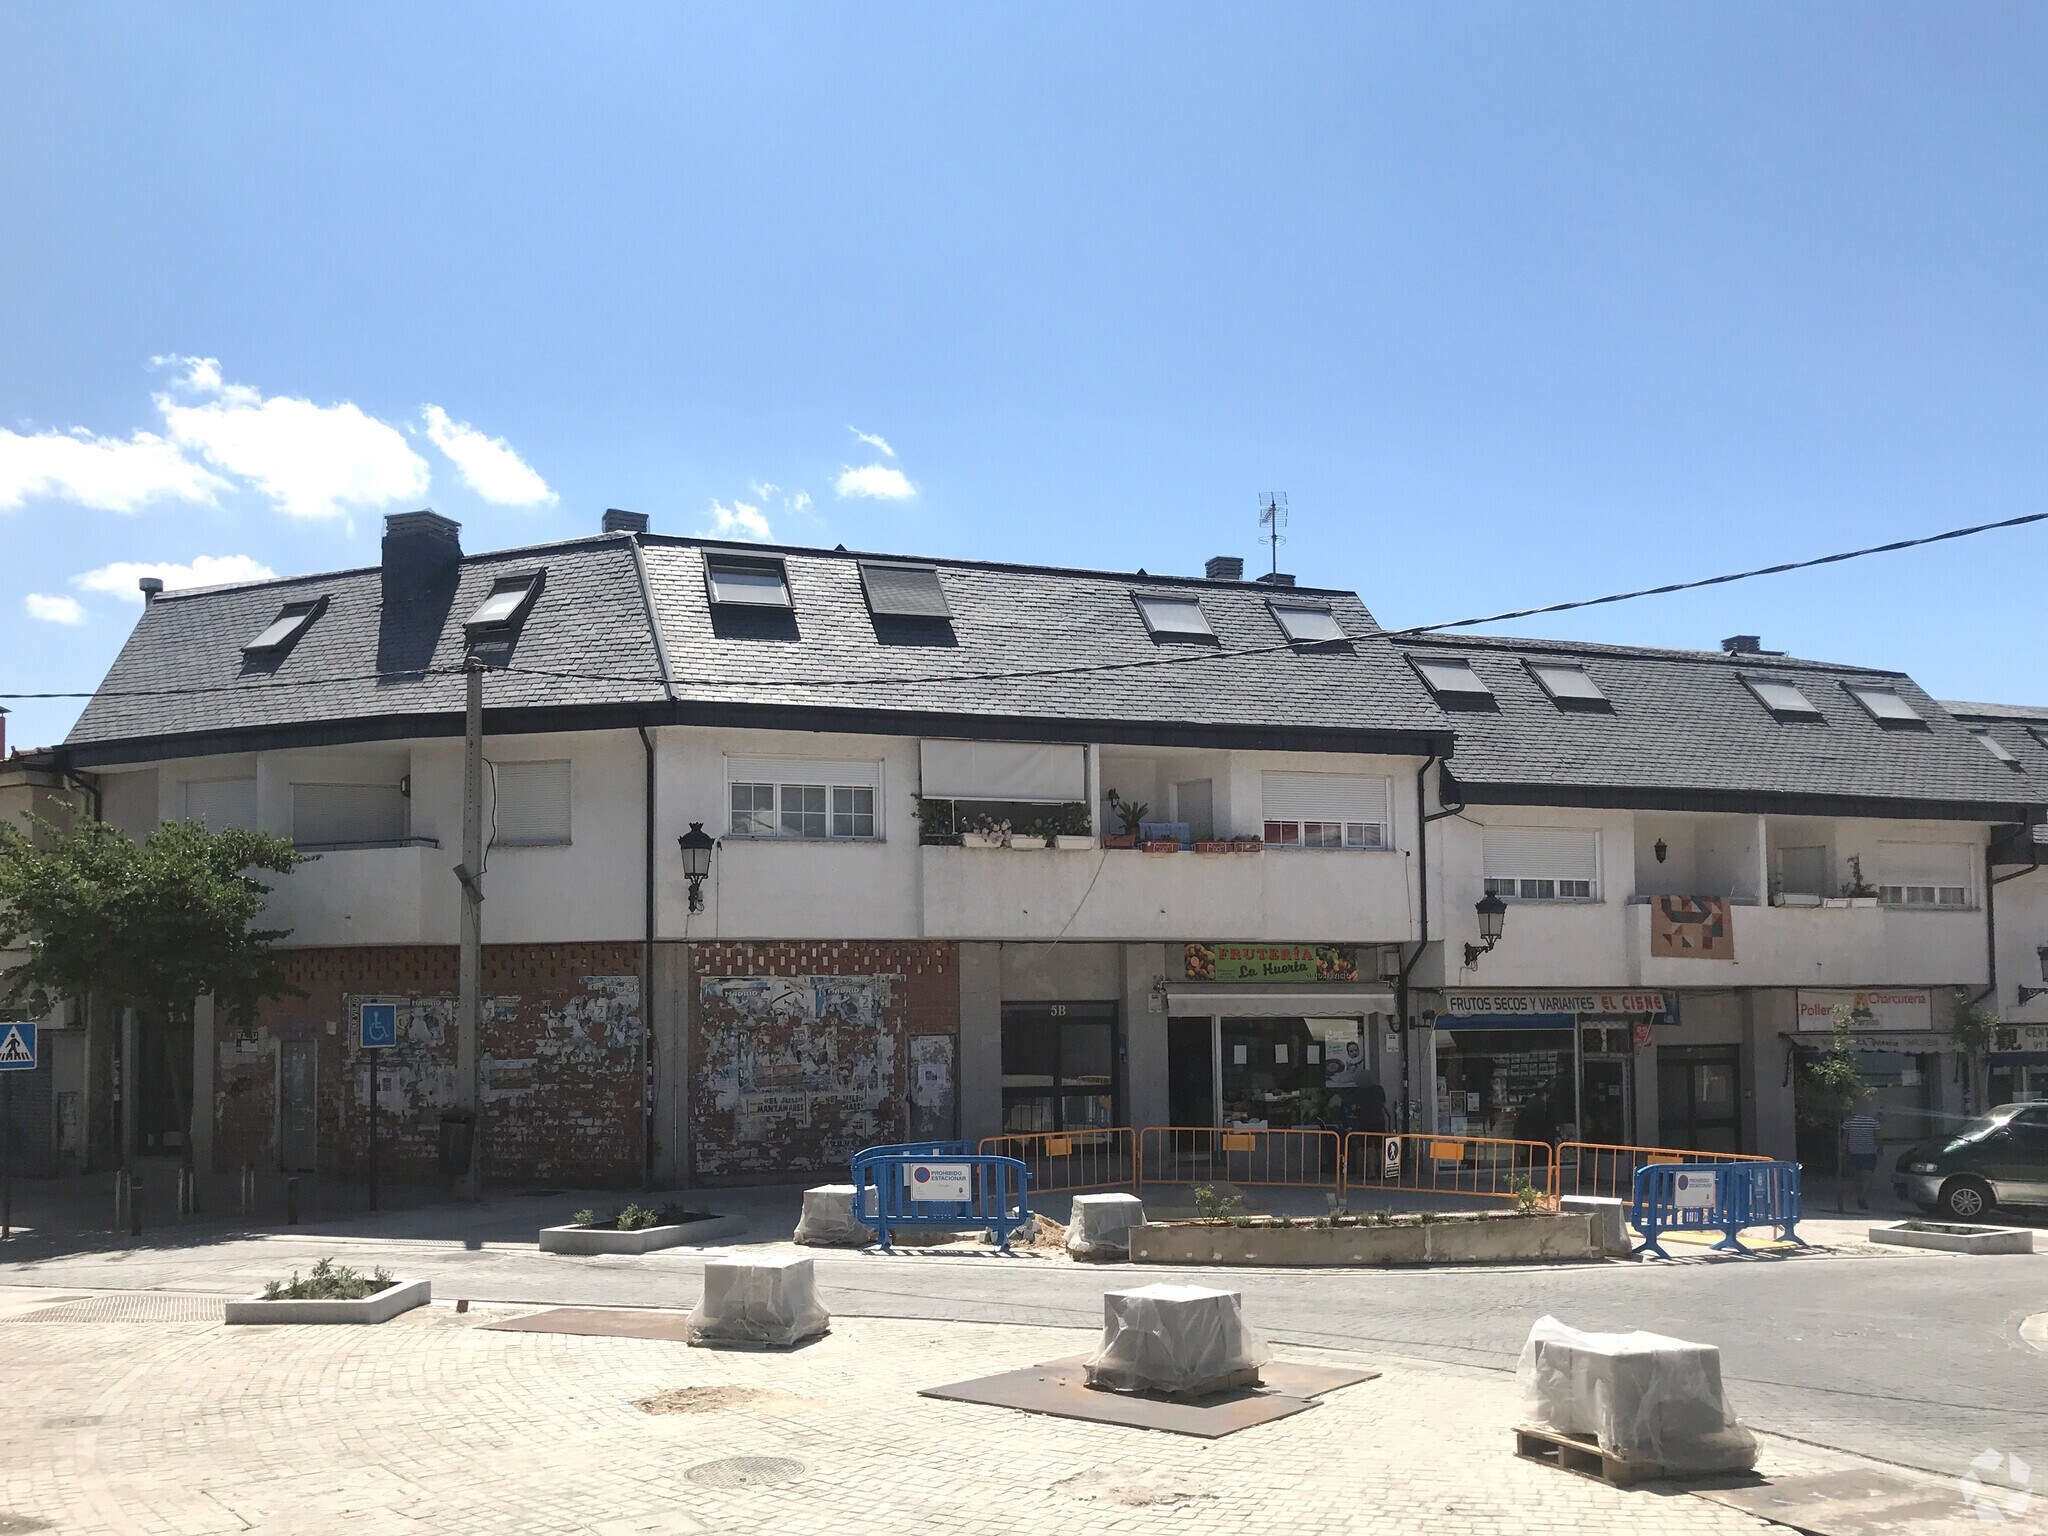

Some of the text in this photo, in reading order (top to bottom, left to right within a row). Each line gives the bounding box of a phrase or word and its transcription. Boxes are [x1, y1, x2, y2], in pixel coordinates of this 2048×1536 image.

[1218, 946, 1313, 961] FRUTERÍA
[1238, 965, 1258, 978] La
[1263, 961, 1309, 976] Huerta
[725, 989, 758, 998] MADRID
[1450, 995, 1662, 1011] FRUTOS SECOS Y VARIANTES EL CISNE
[1800, 1003, 1836, 1016] Poller
[1050, 1004, 1067, 1017] 5B
